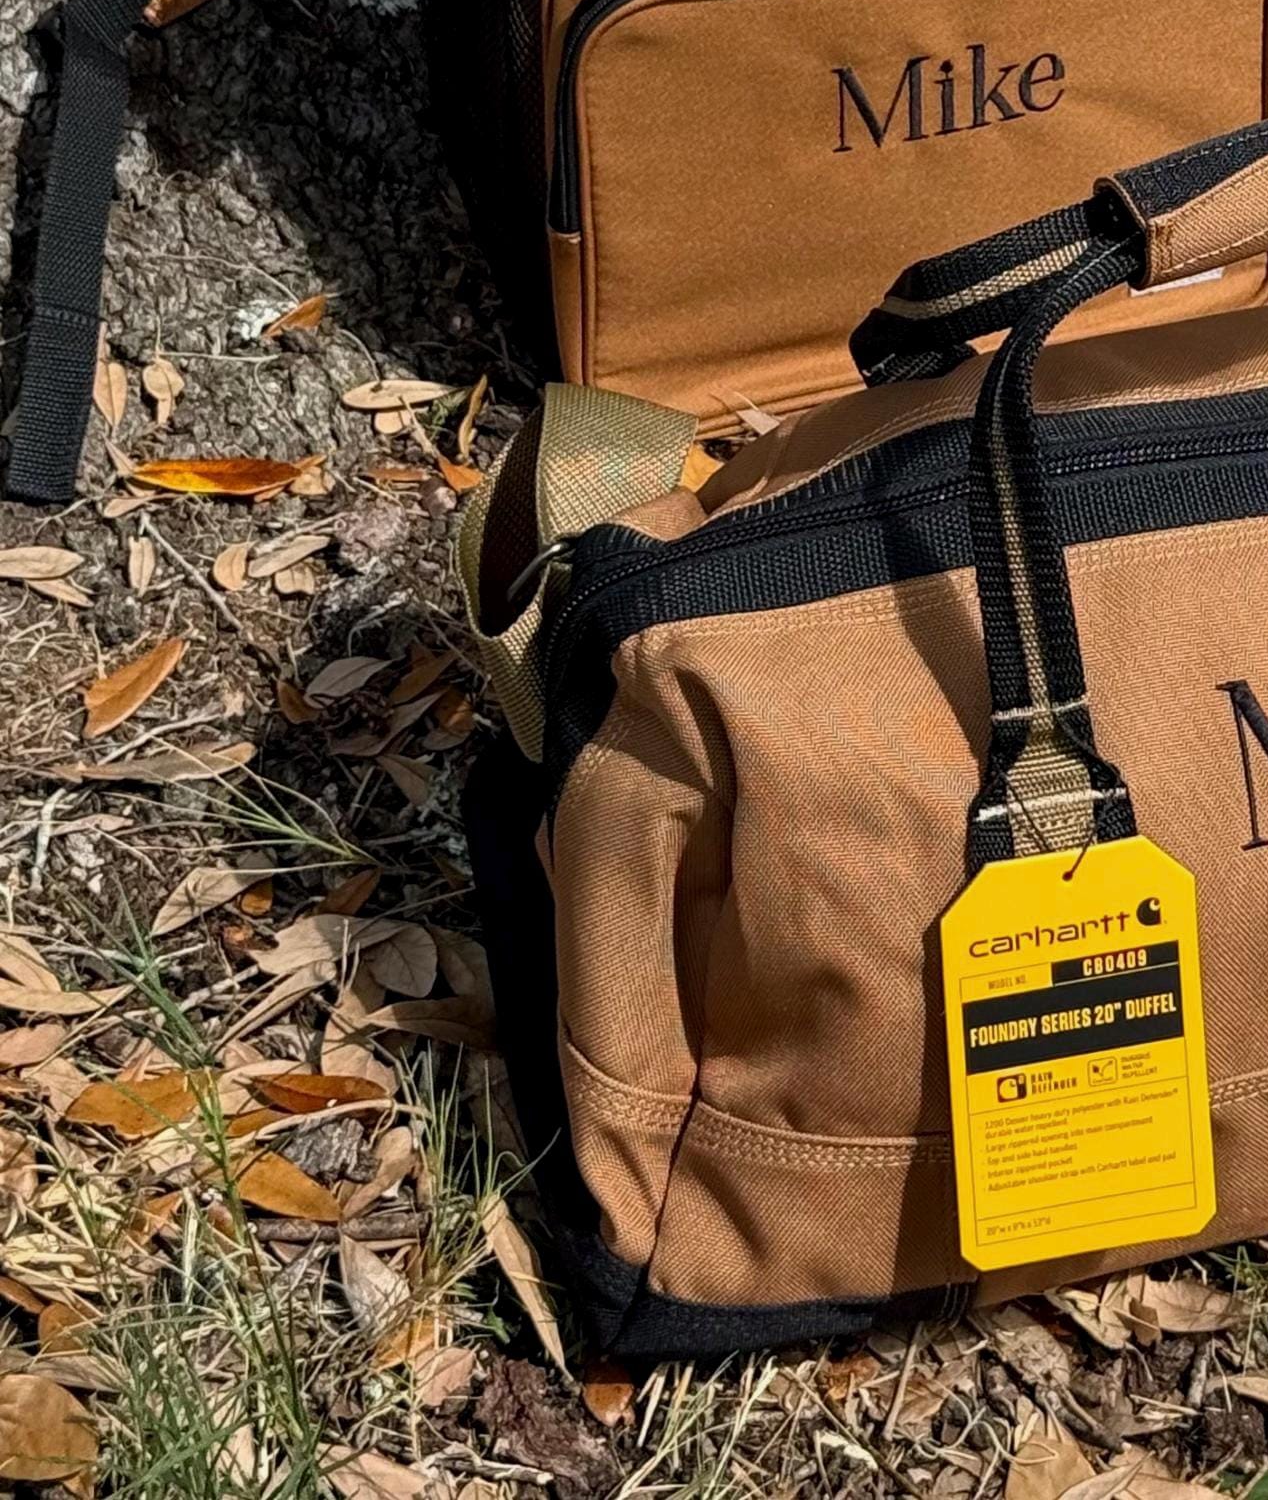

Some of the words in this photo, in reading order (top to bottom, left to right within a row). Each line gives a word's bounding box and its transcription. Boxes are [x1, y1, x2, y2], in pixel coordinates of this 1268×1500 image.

[831, 43, 1065, 153] Mike
[969, 911, 1130, 958] carhartt
[1082, 949, 1148, 977] CB0409
[969, 1017, 1038, 1048] FOUNDRY
[1041, 1007, 1092, 1035] SERIES
[1094, 1002, 1122, 1026] 20"
[1125, 992, 1176, 1020] DUFFEL
